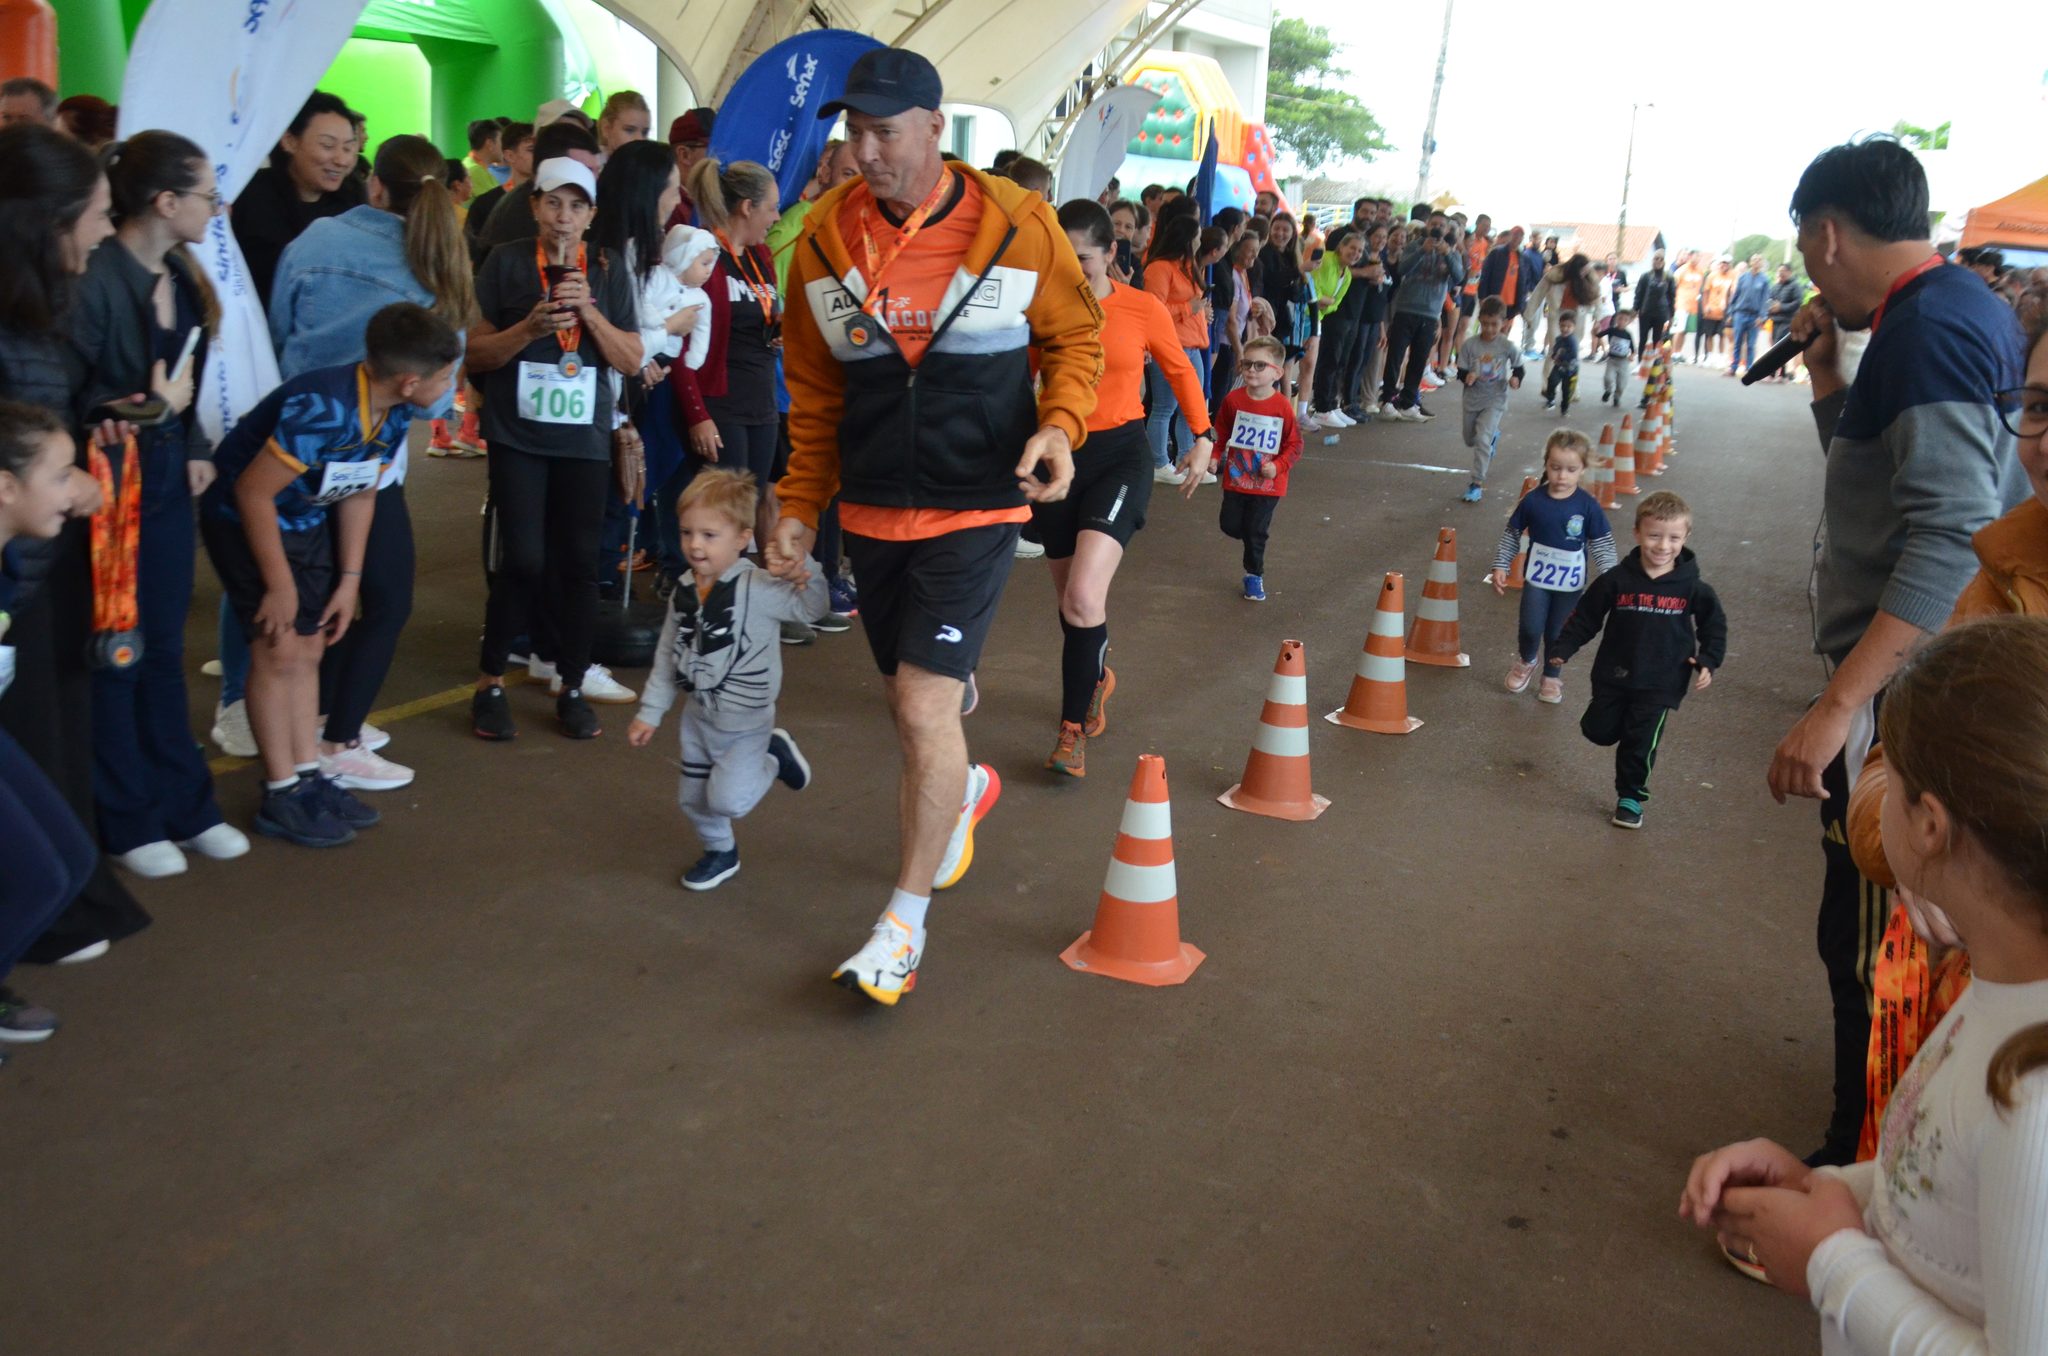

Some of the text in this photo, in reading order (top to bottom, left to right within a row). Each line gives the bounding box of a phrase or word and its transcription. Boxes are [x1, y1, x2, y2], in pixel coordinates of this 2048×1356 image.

[768, 53, 818, 172] Sesc Senac
[530, 386, 585, 419] 106
[1235, 424, 1278, 450] 2215
[1530, 560, 1581, 587] 2275
[1638, 593, 1654, 607] THE
[1657, 595, 1687, 609] WORLD
